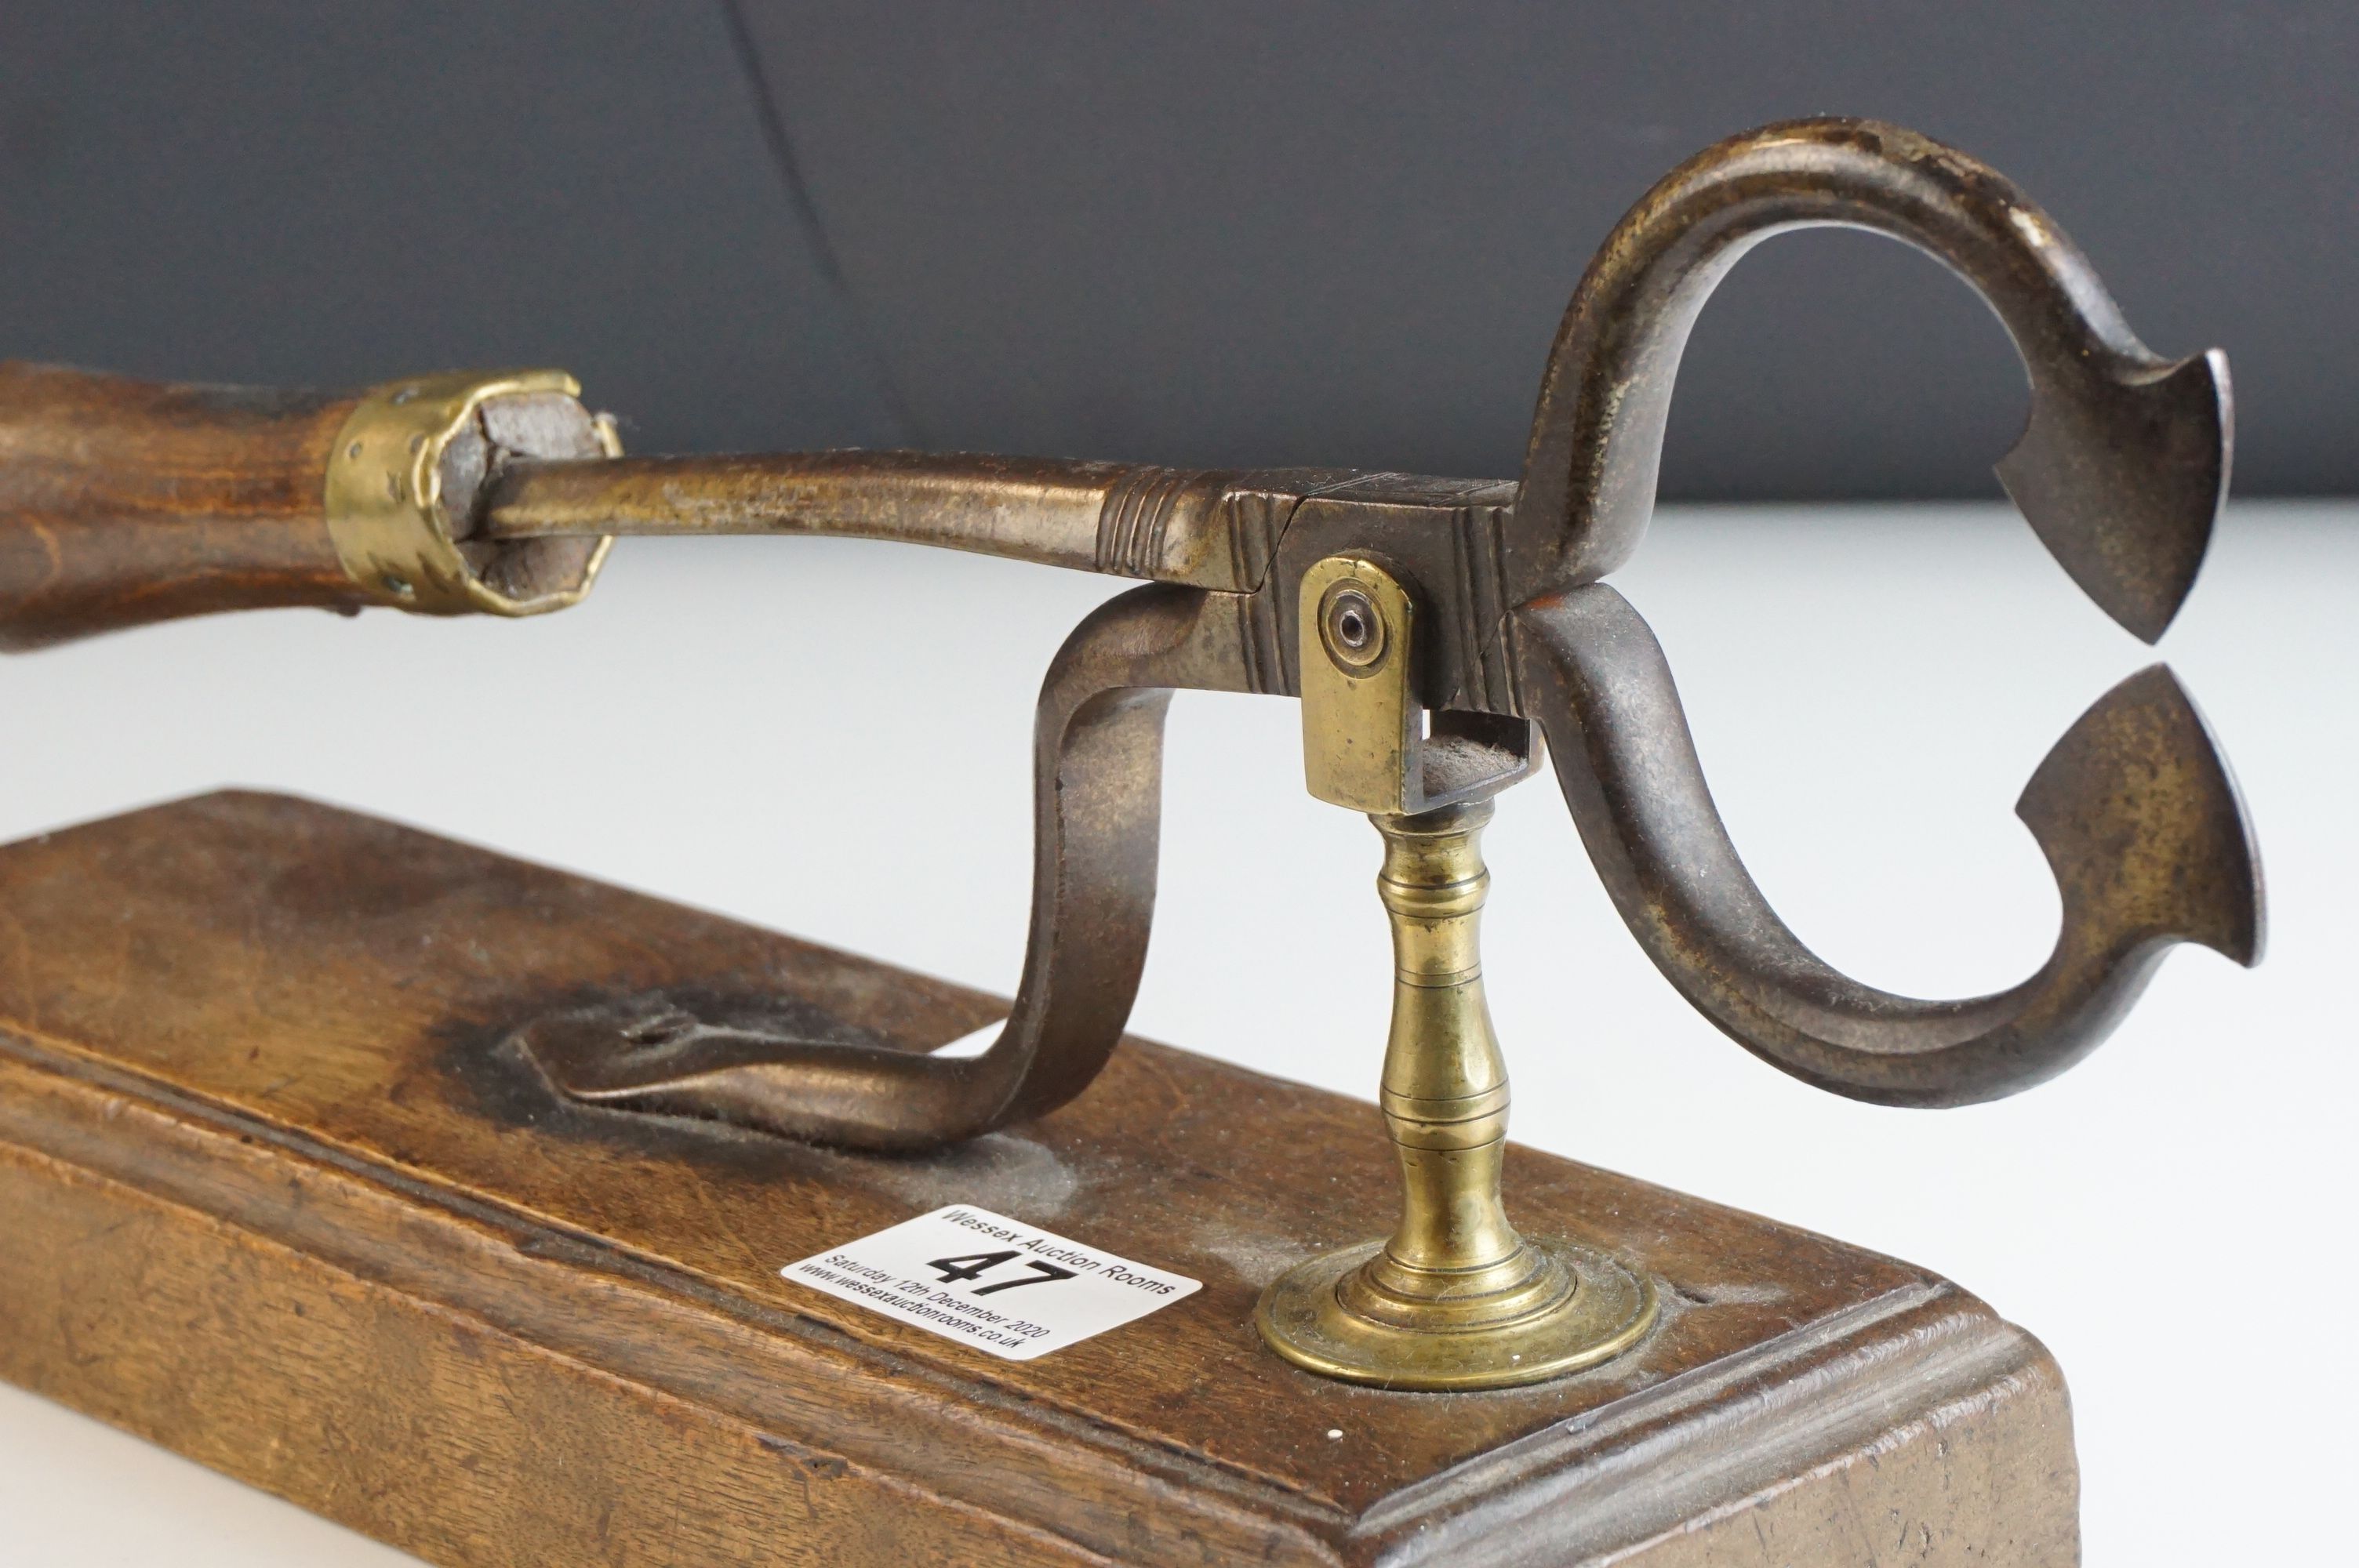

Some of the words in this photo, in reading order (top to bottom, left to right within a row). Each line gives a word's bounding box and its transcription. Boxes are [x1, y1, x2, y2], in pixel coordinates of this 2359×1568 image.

[926, 1250, 1079, 1297] 47
[943, 1210, 1021, 1243] Wessex
[1022, 1233, 1101, 1272] Auction
[1100, 1265, 1176, 1296] Rooms
[798, 1263, 1027, 1348] www.wessexauctionrooms.co.uk
[825, 1254, 896, 1290] Saturday
[900, 1279, 931, 1297] 12th
[931, 1291, 1008, 1325] December
[1005, 1320, 1052, 1338] 2020
